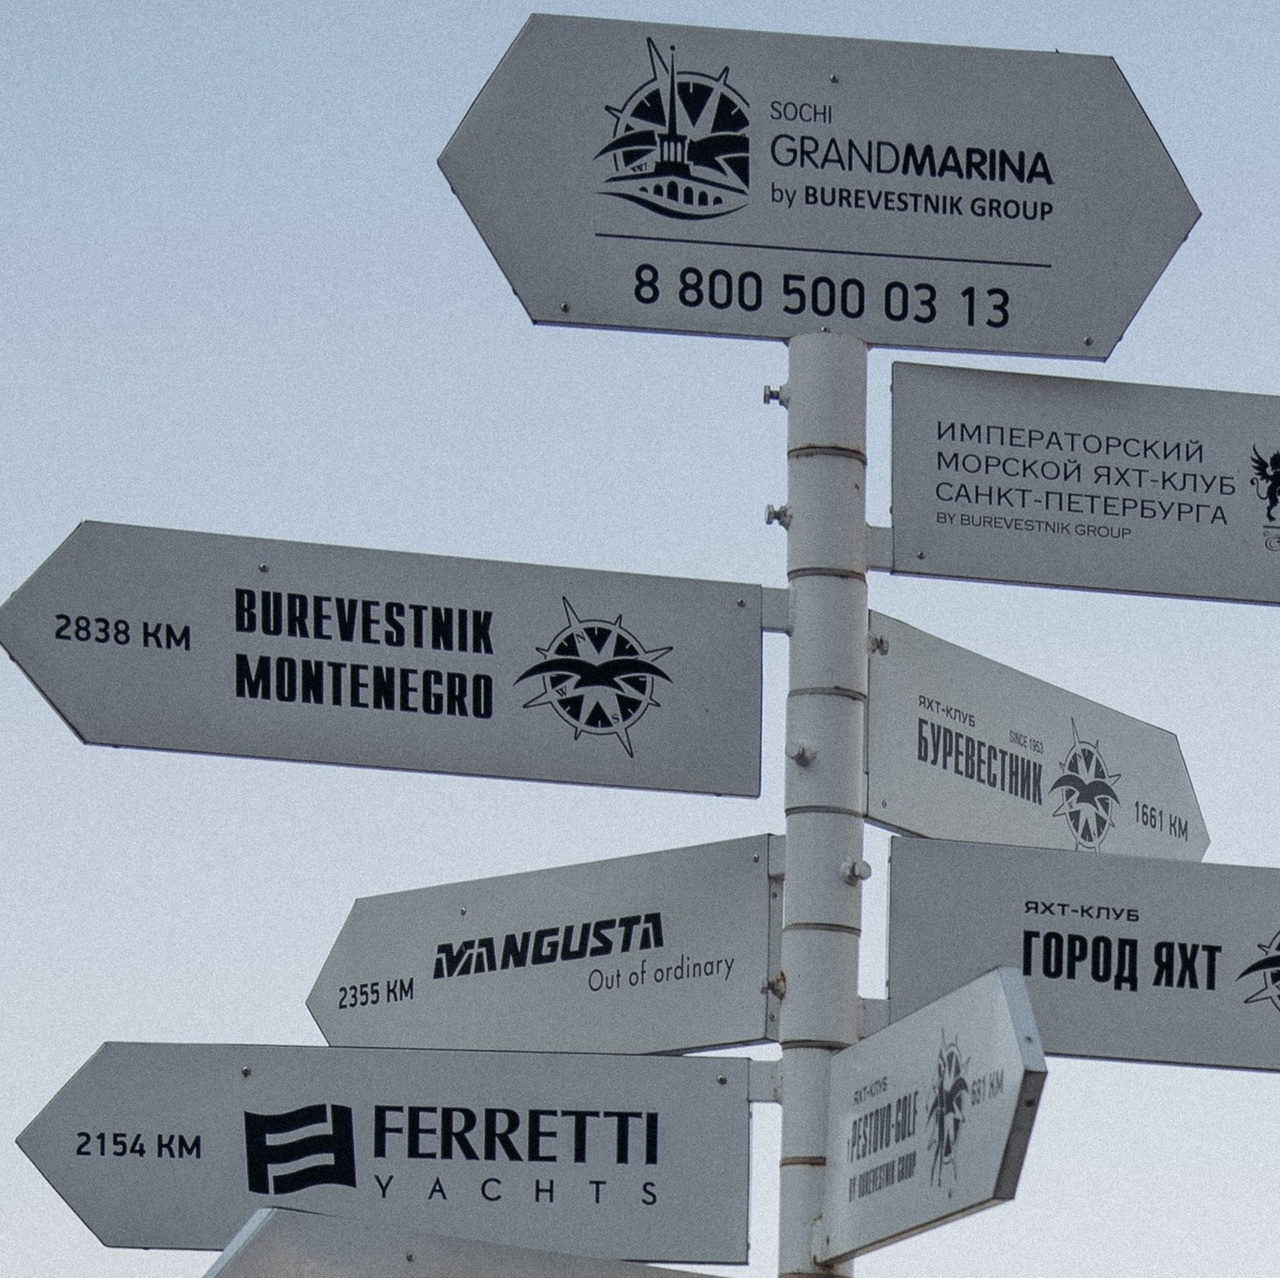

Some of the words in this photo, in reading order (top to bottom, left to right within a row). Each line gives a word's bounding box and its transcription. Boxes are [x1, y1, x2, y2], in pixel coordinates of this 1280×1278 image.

[770, 100, 832, 124] SOCHI
[770, 133, 1054, 190] GRANDMARINA
[771, 182, 797, 209] by
[804, 185, 963, 216] BUREVESTNIK
[970, 197, 1054, 221] GROUP
[634, 263, 660, 305] 8
[678, 266, 763, 312] 800
[783, 273, 865, 319] 500
[884, 281, 937, 324] 03
[961, 286, 1010, 329] 13
[937, 420, 1203, 468] ИМПЕРАТОРСКИЙ
[937, 451, 1082, 485] МОРСКОЙ
[1088, 465, 1236, 500] ЯХТ-КЛУБ
[935, 478, 1233, 530] САНКТ-ПЕТЕРБУРГА
[936, 511, 956, 524] BY
[959, 509, 1074, 535] BUREVESTNIK
[1074, 523, 1132, 539] GROUP
[55, 613, 131, 646] 2838
[235, 588, 494, 659] BUREVESTNIK
[235, 650, 494, 719] MONTENEGRO
[917, 694, 976, 729] ЯХТ-КЛУБ
[1009, 729, 1028, 749] SINCE
[917, 716, 1043, 806] БУРЕВЕСТНИК
[1134, 801, 1163, 831] 1661
[1024, 900, 1140, 923] ЯХТ-КЛУБ
[433, 912, 664, 982] MANGUSTA
[1022, 930, 1138, 992] ГОРОД
[1152, 941, 1222, 991] ЯХТ
[588, 968, 622, 992] Out
[628, 958, 647, 987] of
[653, 954, 735, 984] ordinary
[338, 981, 380, 1010] 2355
[76, 1131, 146, 1158] 2154
[374, 1105, 659, 1165] FERRETTI
[374, 1174, 657, 1206] YACHTS
